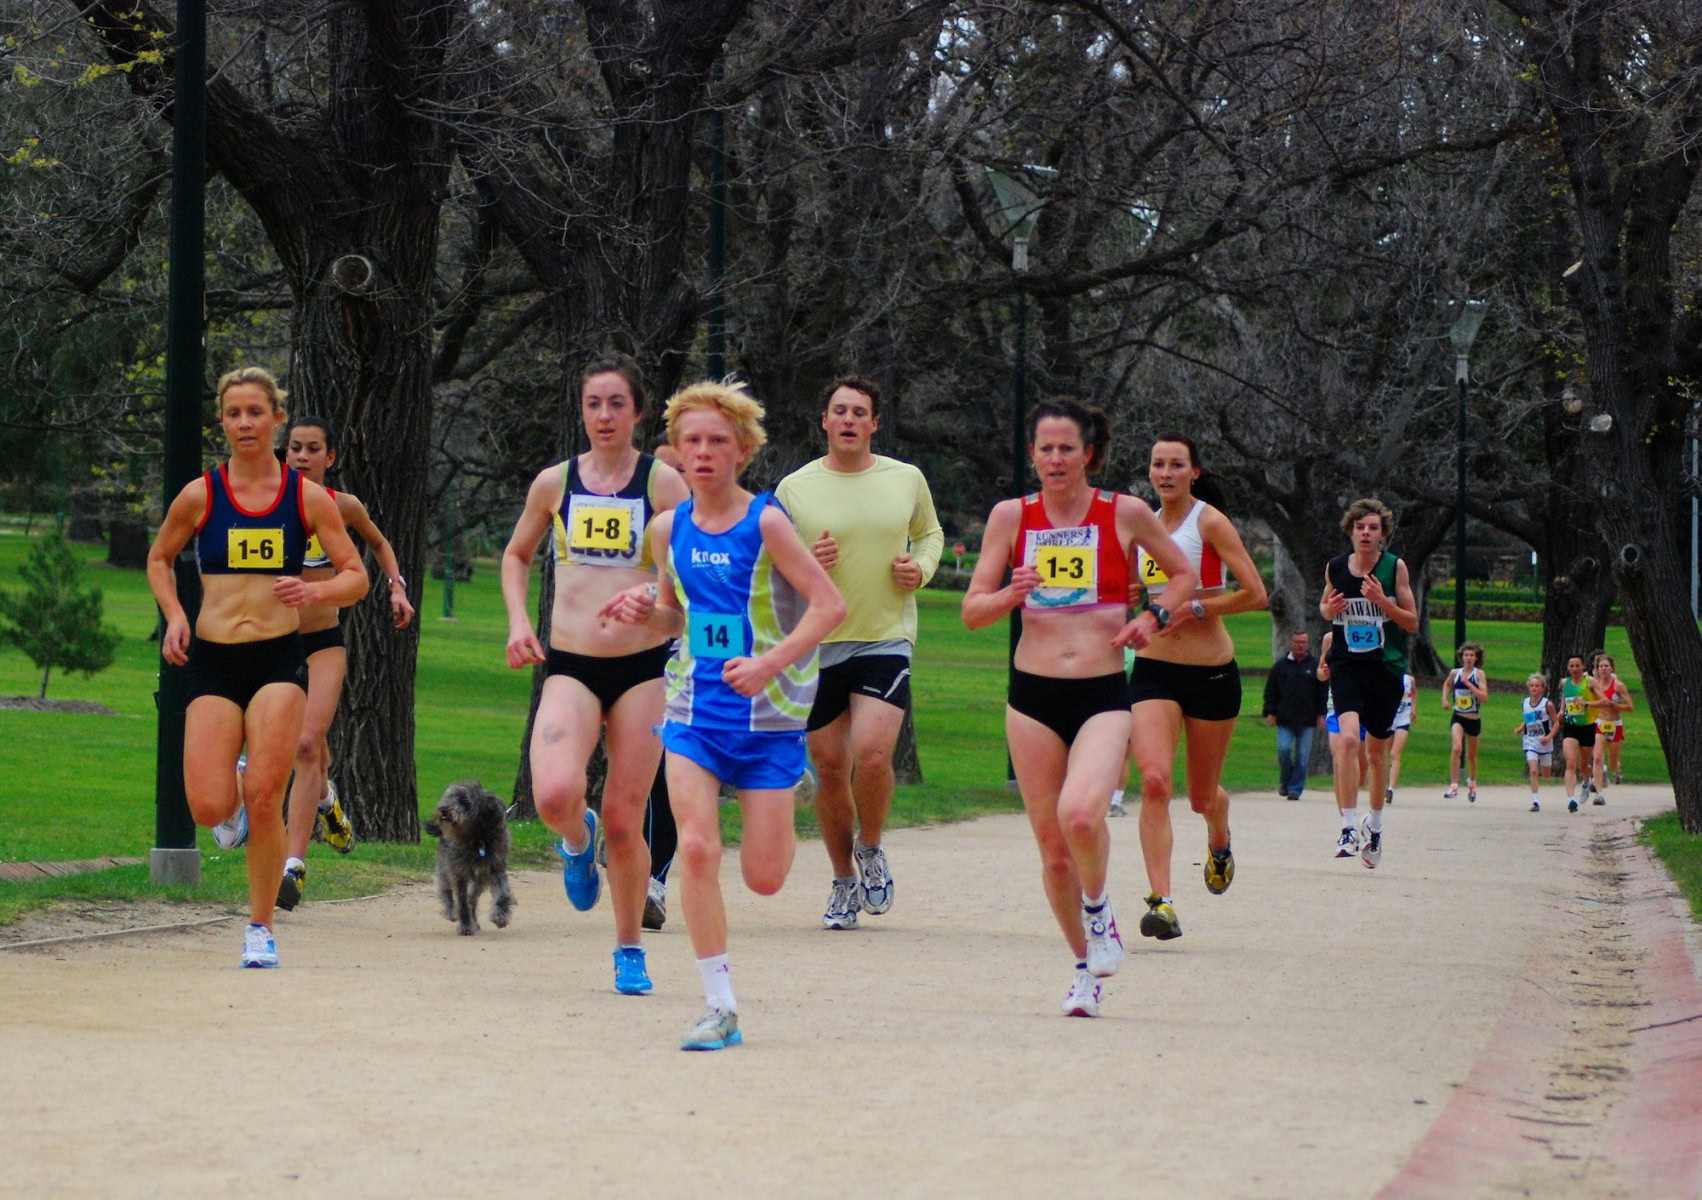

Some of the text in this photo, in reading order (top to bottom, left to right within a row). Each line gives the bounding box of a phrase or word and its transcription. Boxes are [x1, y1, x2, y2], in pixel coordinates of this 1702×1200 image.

[583, 517, 620, 540] 1-8
[238, 538, 274, 560] 1-6
[691, 547, 730, 565] knox
[1046, 556, 1084, 579] 1-3
[1146, 559, 1161, 577] 2-
[703, 624, 730, 649] 14
[1352, 630, 1374, 643] 6-2
